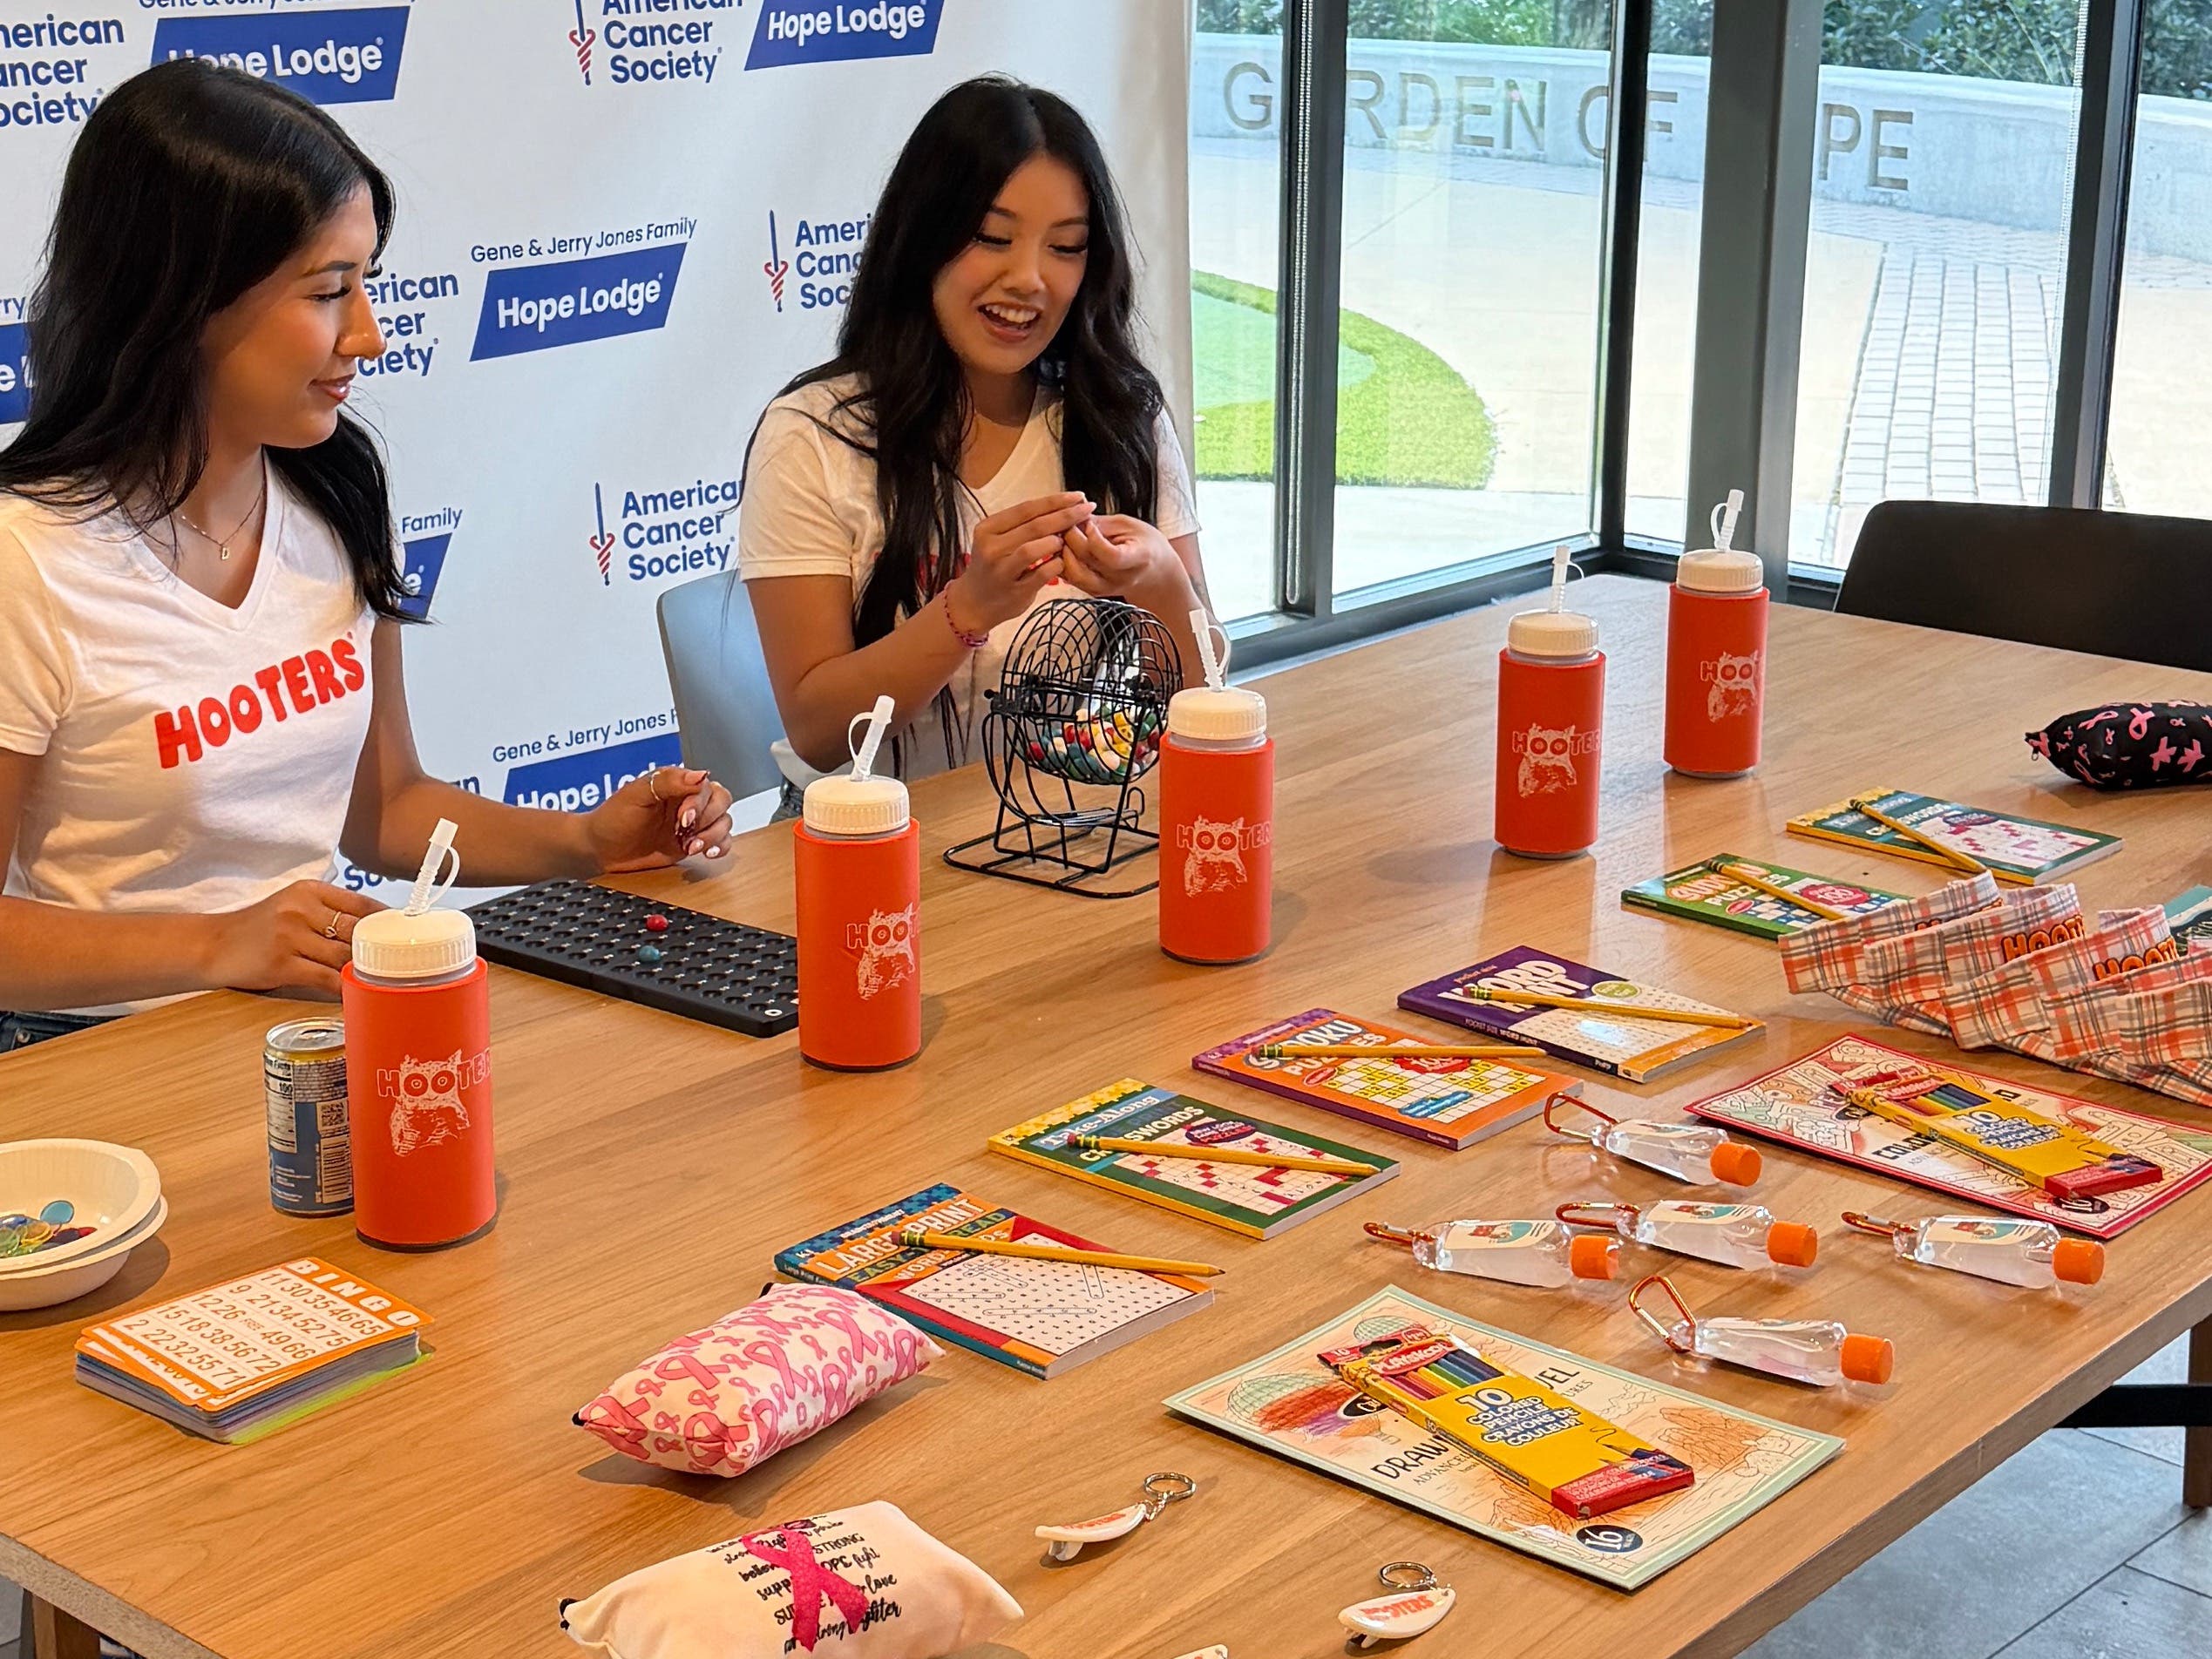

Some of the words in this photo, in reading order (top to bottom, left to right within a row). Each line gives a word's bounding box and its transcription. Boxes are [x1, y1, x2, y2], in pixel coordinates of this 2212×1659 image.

[0, 13, 125, 48] erican
[603, 20, 713, 50] Cancer
[768, 10, 831, 46] Hope
[836, 1, 926, 39] Lodge
[0, 58, 87, 87] ncer
[272, 40, 382, 84] Lodge
[610, 50, 719, 85] Society
[1224, 62, 1547, 152] GRDEN
[1818, 103, 1914, 192] PE
[471, 245, 523, 262] Gene
[528, 239, 542, 257] &
[547, 236, 593, 256] Jerry
[596, 228, 642, 249] Jones
[647, 217, 697, 240] Family
[795, 213, 871, 247] Ameri
[796, 251, 863, 278] Canc
[364, 273, 458, 304] erican
[498, 295, 575, 333] Hope
[580, 278, 662, 316] Lodge
[378, 312, 425, 339] cer
[358, 342, 433, 376] ciety
[622, 480, 741, 518] America
[402, 507, 463, 534] Family
[623, 512, 725, 549] Cancer
[628, 542, 730, 580] Society
[154, 638, 365, 769] HOOTERS
[492, 741, 542, 762] Gene
[547, 734, 560, 751] &
[565, 725, 610, 747] Jerry
[615, 714, 667, 736] Jones
[1952, 1110, 2003, 1128] 10
[904, 1198, 985, 1236] PRINT
[261, 1272, 290, 1286] 11
[281, 1283, 312, 1297] 30
[302, 1295, 338, 1310] 35
[329, 1308, 360, 1323] 46
[349, 1319, 383, 1336] 65
[286, 1259, 421, 1327] BINGO
[191, 1294, 223, 1308] 12
[211, 1304, 246, 1320] 26
[261, 1331, 292, 1345] 49
[282, 1343, 316, 1359] 66
[229, 1284, 252, 1295] 9
[247, 1295, 281, 1309] 21
[269, 1305, 302, 1321] 34
[292, 1317, 326, 1334] 52
[316, 1330, 351, 1347] 75
[124, 1319, 149, 1330] 2
[142, 1329, 176, 1344] 22
[165, 1341, 199, 1358] 32
[187, 1353, 223, 1371] 55
[212, 1367, 247, 1385] 71
[157, 1306, 189, 1319] 15
[180, 1317, 211, 1331] 18
[200, 1329, 234, 1344] 38
[223, 1341, 257, 1358] 56
[247, 1354, 281, 1372] 72
[1456, 1388, 1513, 1412] 10
[1467, 1396, 1544, 1425] COLORED
[1484, 1405, 1551, 1432] PENCILS
[1483, 1412, 1558, 1443] CRAYONS
[1553, 1406, 1581, 1421] DE
[1508, 1419, 1584, 1446] COULEUR
[1585, 1527, 1625, 1550] 16
